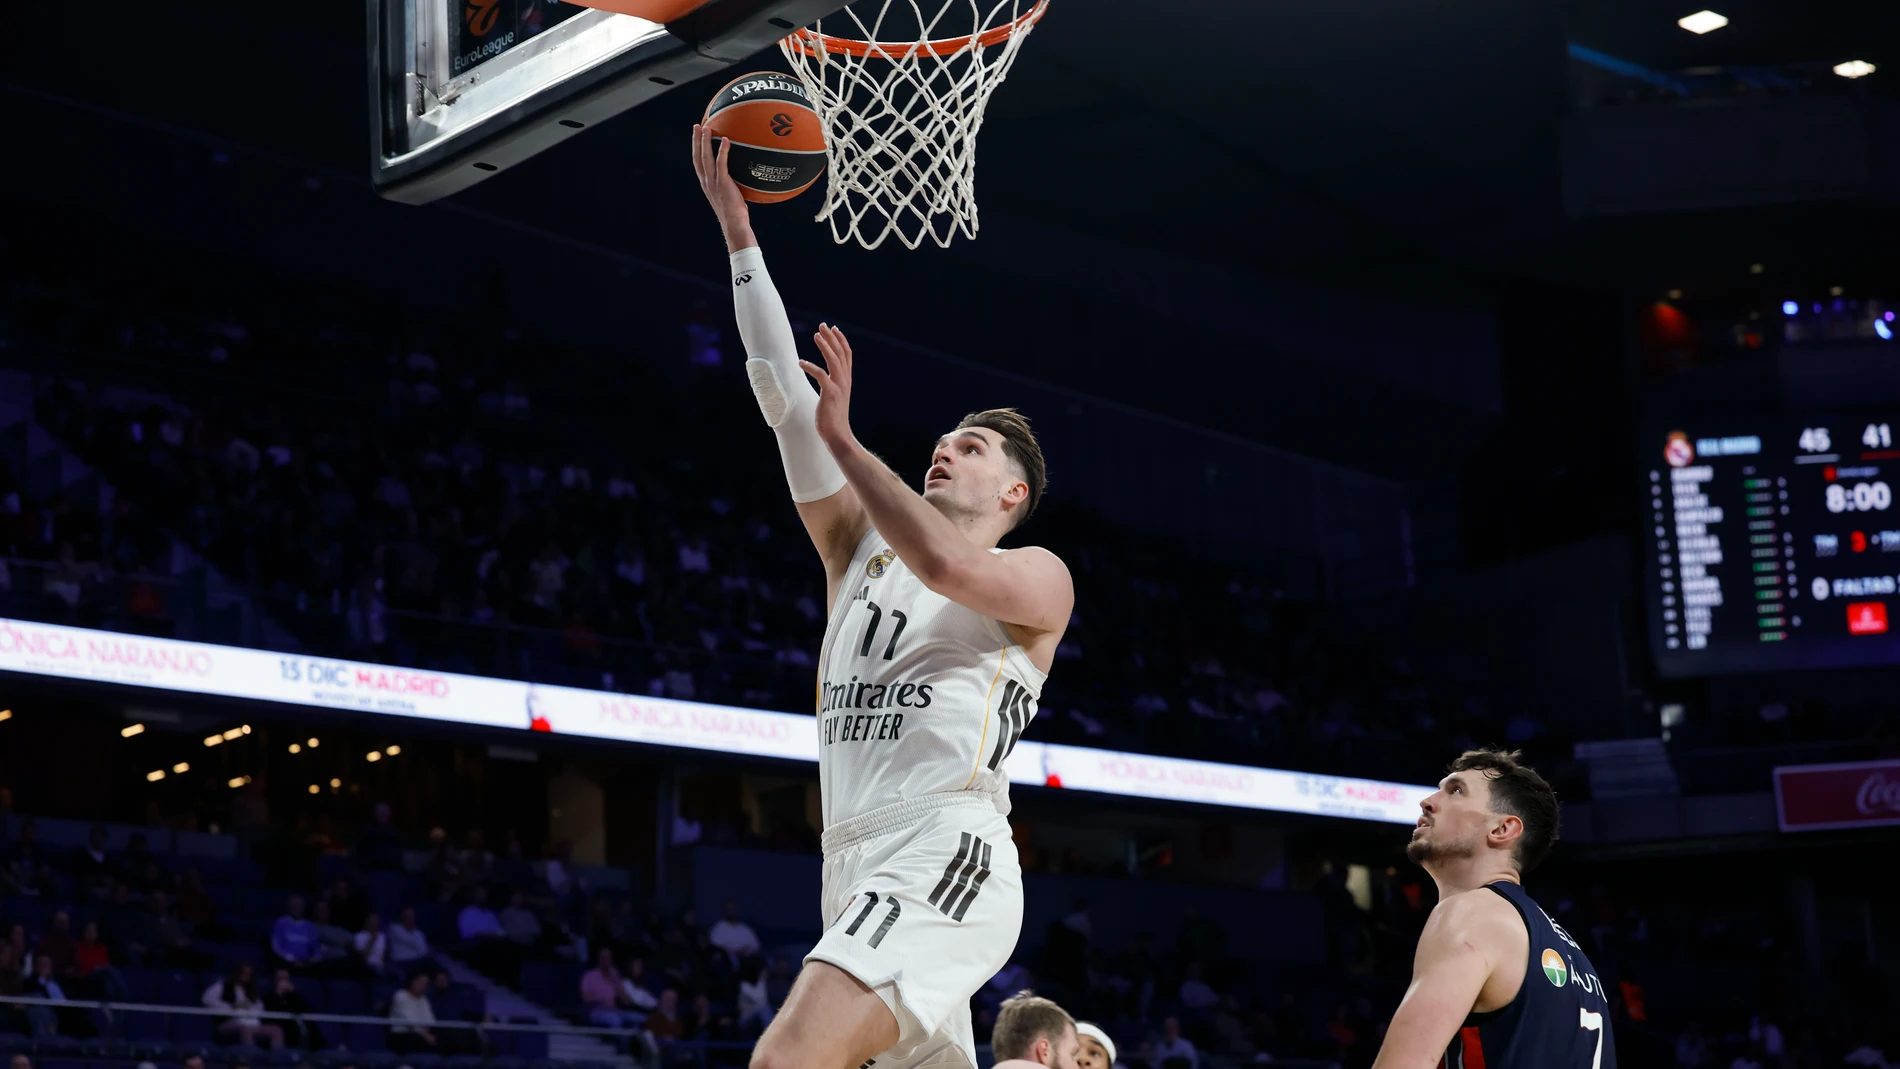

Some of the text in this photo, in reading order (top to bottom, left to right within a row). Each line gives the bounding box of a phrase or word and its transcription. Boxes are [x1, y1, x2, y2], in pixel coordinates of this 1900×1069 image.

[454, 31, 515, 70] EuroLeague
[731, 79, 811, 102] SPALDIN
[1798, 427, 1832, 452] 45
[1862, 423, 1892, 448] 41
[1825, 481, 1892, 513] 8:00
[0, 620, 79, 660] ÓNICA
[87, 639, 214, 677] NARANJO
[307, 662, 350, 688] DIC
[355, 669, 450, 698] MADRID
[822, 675, 933, 713] Emirates
[824, 713, 904, 746] FLY BETTER
[1580, 1007, 1603, 1069] 7
